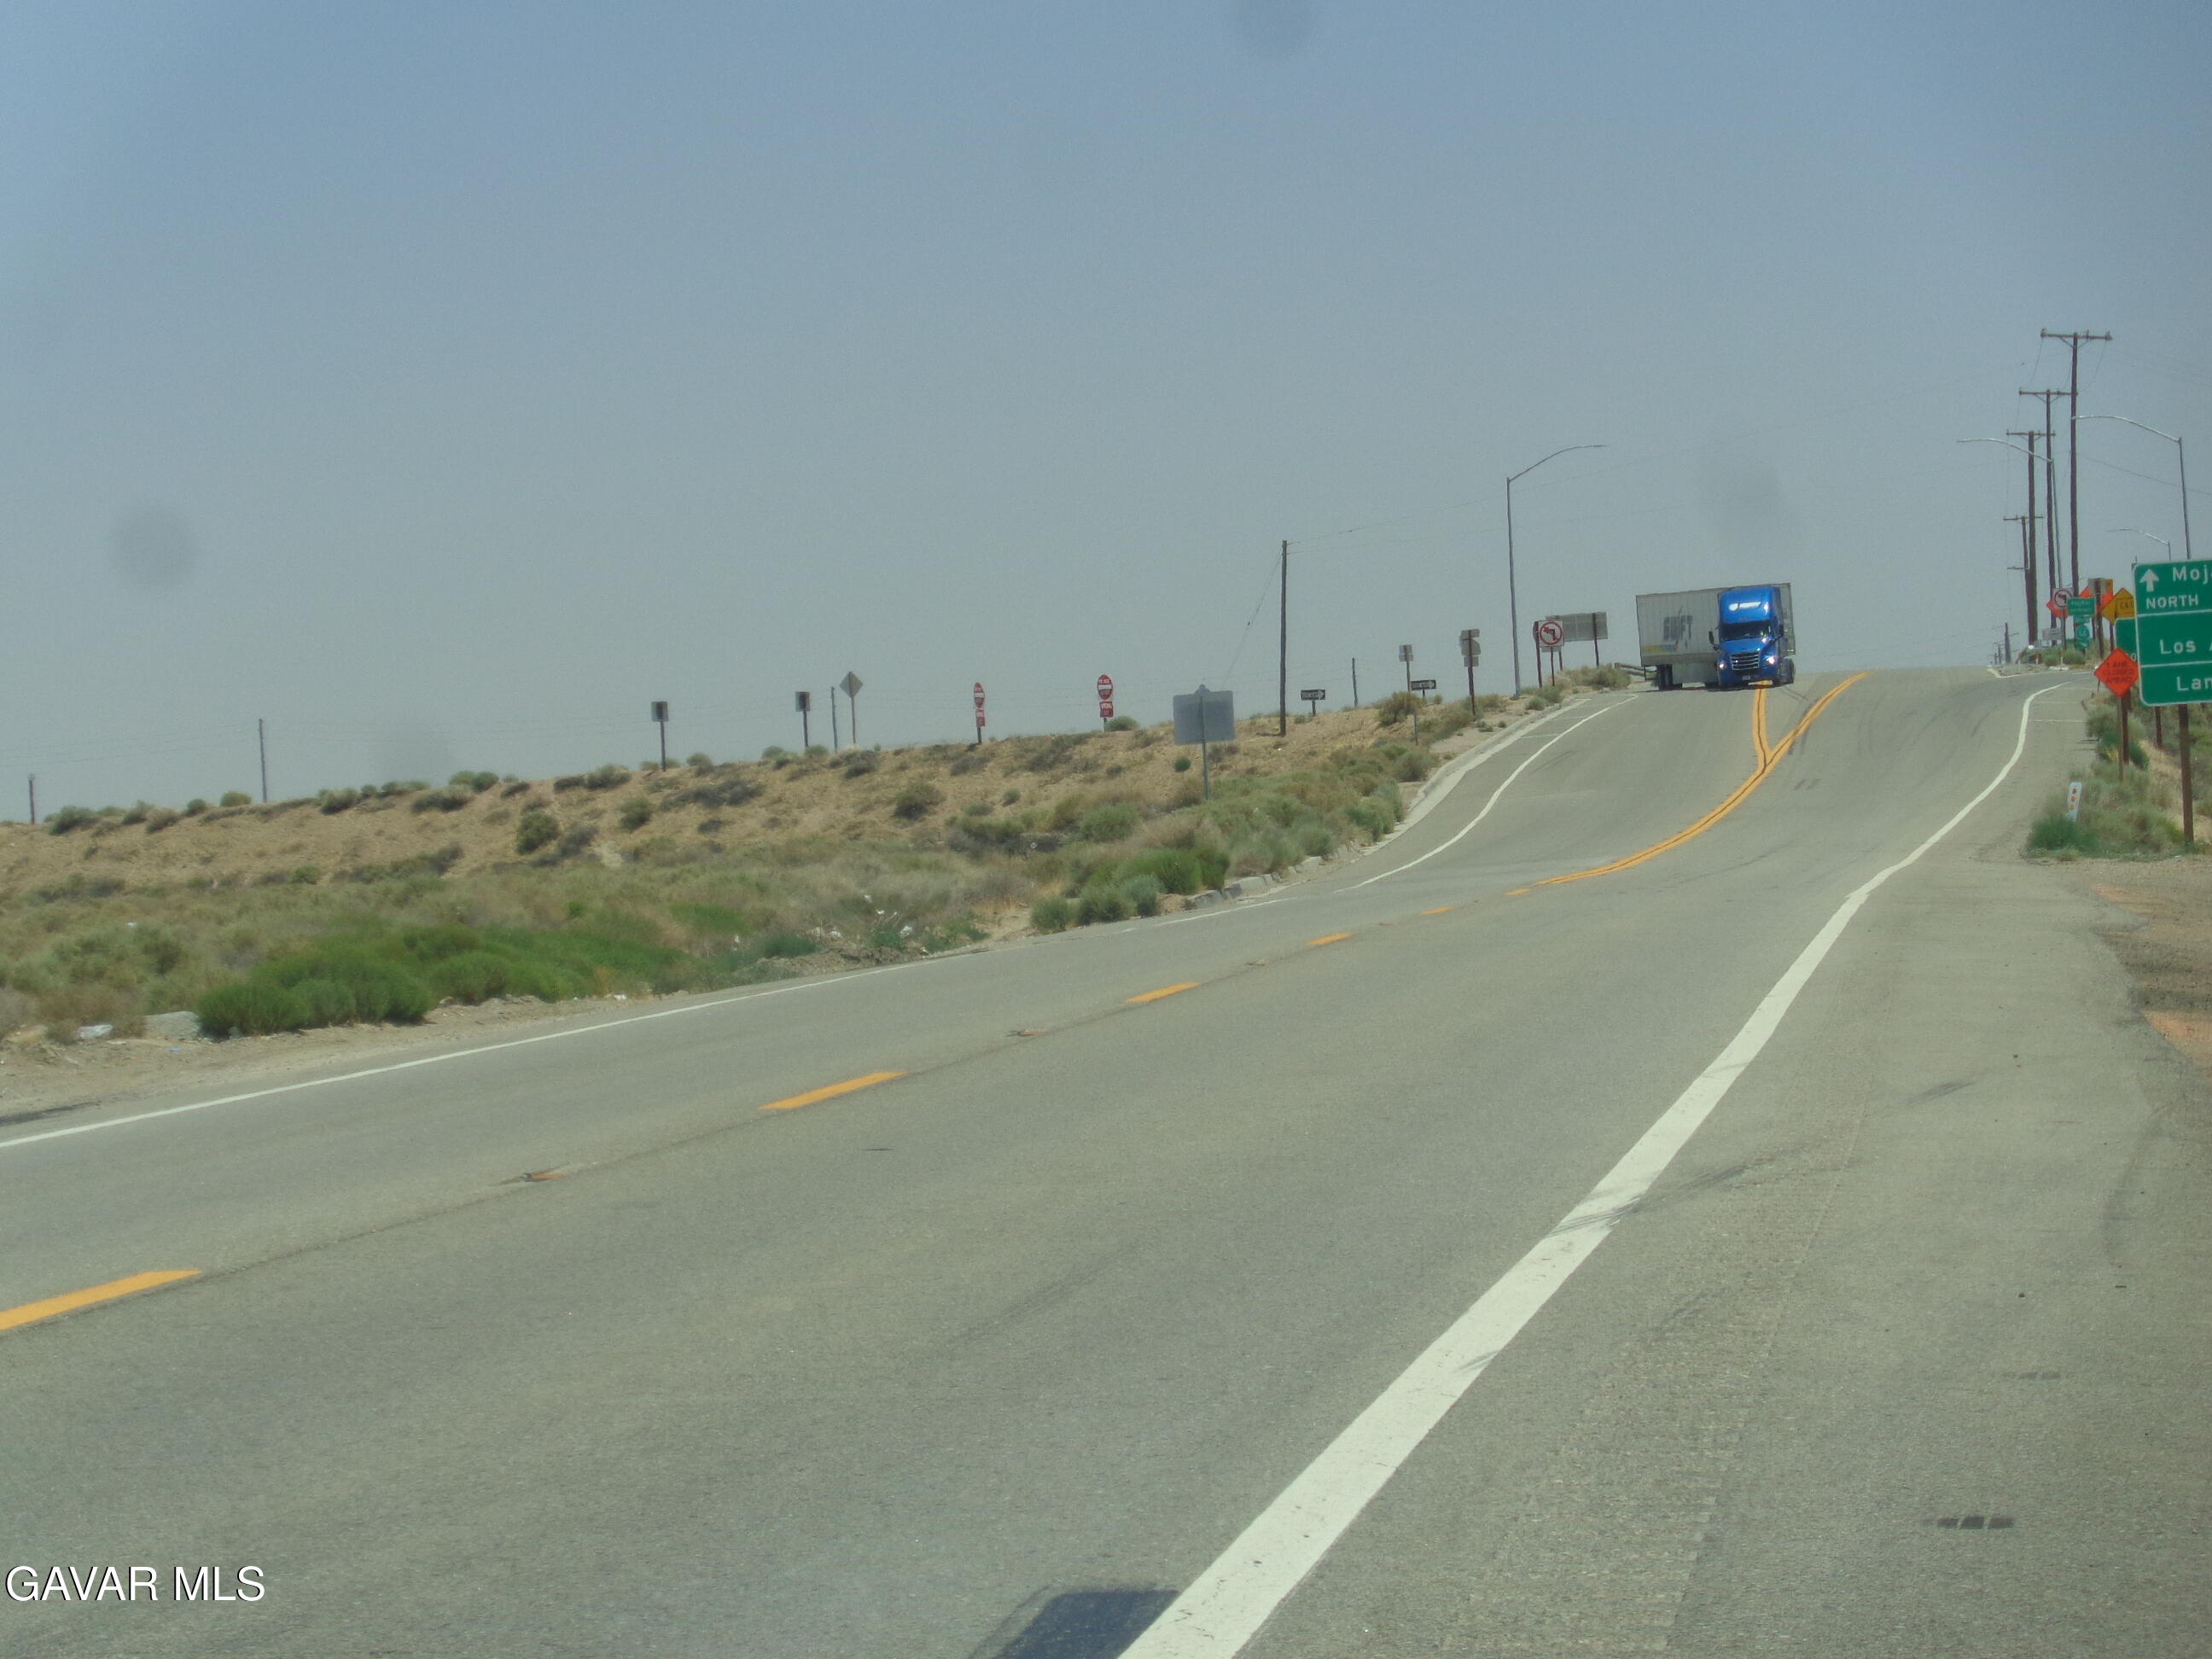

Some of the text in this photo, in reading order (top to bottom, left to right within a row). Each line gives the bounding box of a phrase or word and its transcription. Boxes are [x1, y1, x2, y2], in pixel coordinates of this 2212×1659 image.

[2172, 564, 2212, 585] Moj
[2146, 593, 2199, 609] NORTH
[2159, 638, 2197, 655] Los
